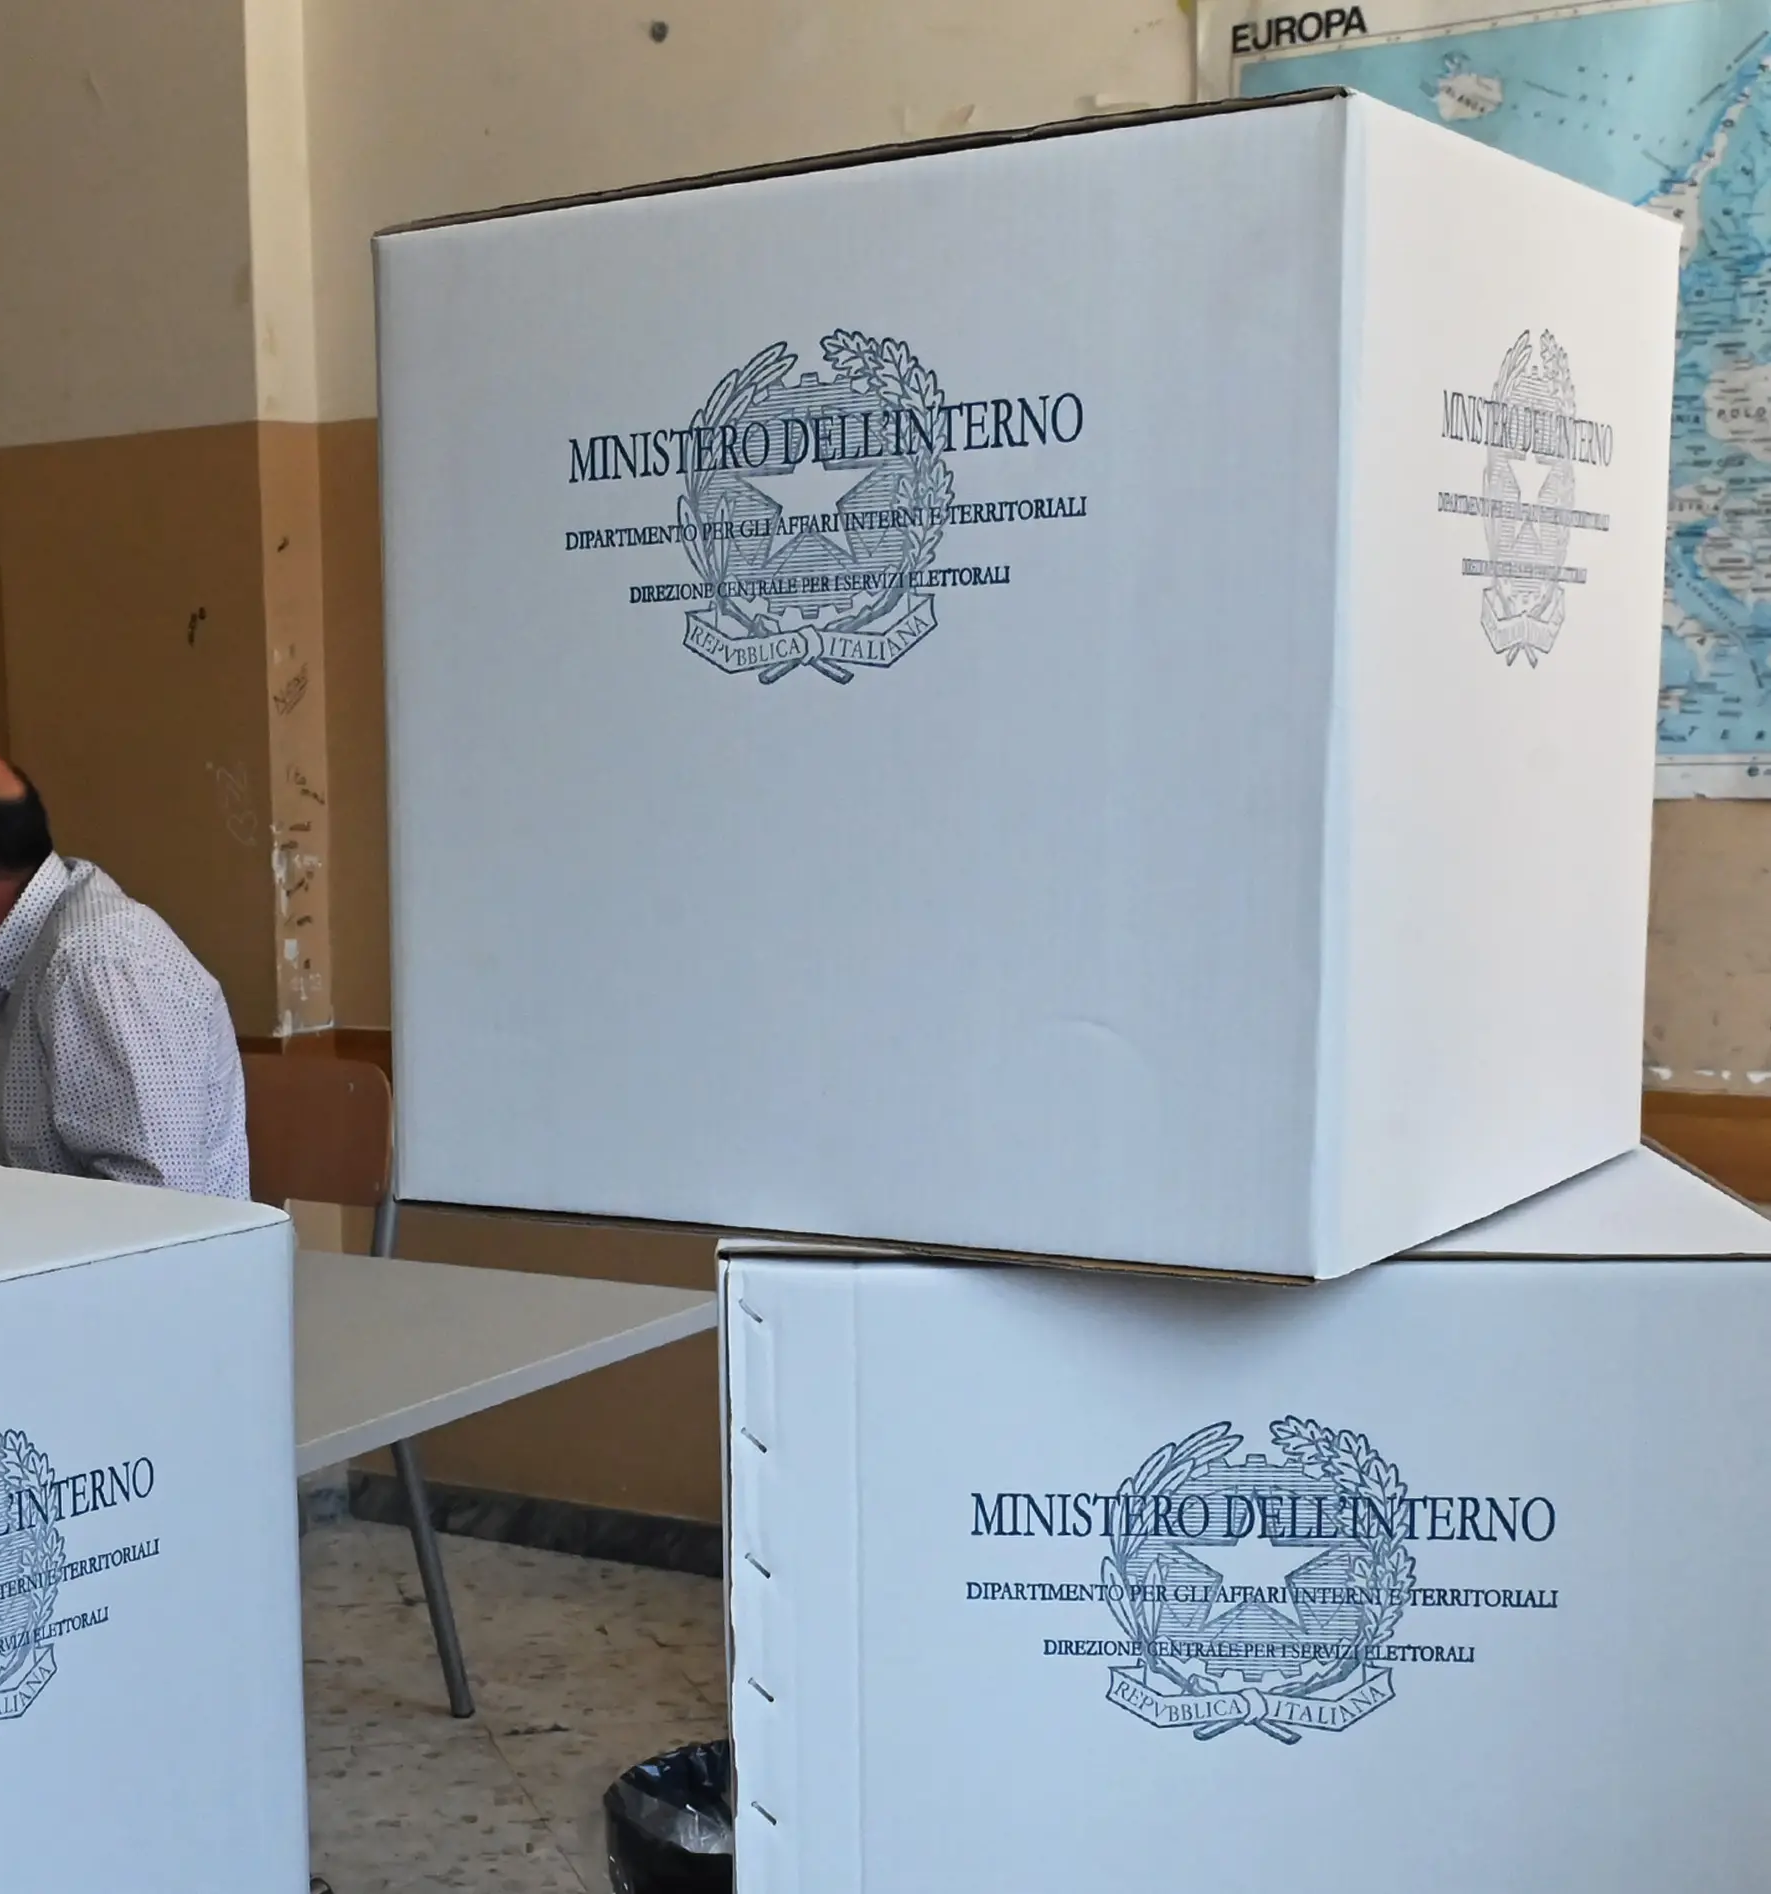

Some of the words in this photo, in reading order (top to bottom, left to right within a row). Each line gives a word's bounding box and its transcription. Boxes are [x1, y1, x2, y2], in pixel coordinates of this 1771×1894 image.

[1232, 6, 1367, 54] EUROPA
[569, 421, 770, 483] MINISTERO
[784, 393, 1084, 464] DELL'INTERNO
[1442, 390, 1519, 449] MINISTERO
[565, 522, 697, 550] DIPARTIMENTO
[702, 520, 735, 540] PER
[740, 518, 773, 538] GLI
[776, 513, 840, 536] AFFARI
[844, 508, 924, 532] INTERNI
[930, 507, 944, 526] E
[946, 496, 1088, 525] TERRITORIALI
[630, 582, 715, 604] DIREZIONE
[717, 578, 798, 599] CENTRALE
[801, 576, 831, 594] PER
[843, 572, 904, 592] SERVIZI
[908, 566, 1010, 587] ELETTORALI
[690, 624, 803, 668] REPVBBLICA
[828, 614, 930, 662] ITALIANA
[971, 1493, 1210, 1537] MINISTERO
[1223, 1495, 1557, 1542] DELL'INTERNO
[46, 1568, 58, 1586] E
[59, 1538, 160, 1583] TERRITORIALI
[966, 1581, 1124, 1602] DIPARTIMENTO
[1129, 1583, 1169, 1603] PER
[1172, 1584, 1213, 1604] GLI
[1215, 1584, 1289, 1605] AFFARI
[1292, 1586, 1384, 1606] INTERNI
[1388, 1587, 1403, 1606] E
[1407, 1587, 1559, 1608] TERRITORIALI
[34, 1607, 109, 1645] ELETTORALI
[1043, 1639, 1143, 1657] DIREZIONE
[1147, 1640, 1240, 1659] CENTRALE
[1244, 1641, 1278, 1659] PER
[1291, 1642, 1360, 1662] SERVIZI
[1364, 1643, 1476, 1663] ELETTORALI
[1113, 1680, 1245, 1725] REPVBBLICA
[1273, 1682, 1387, 1726] ITALIANA
